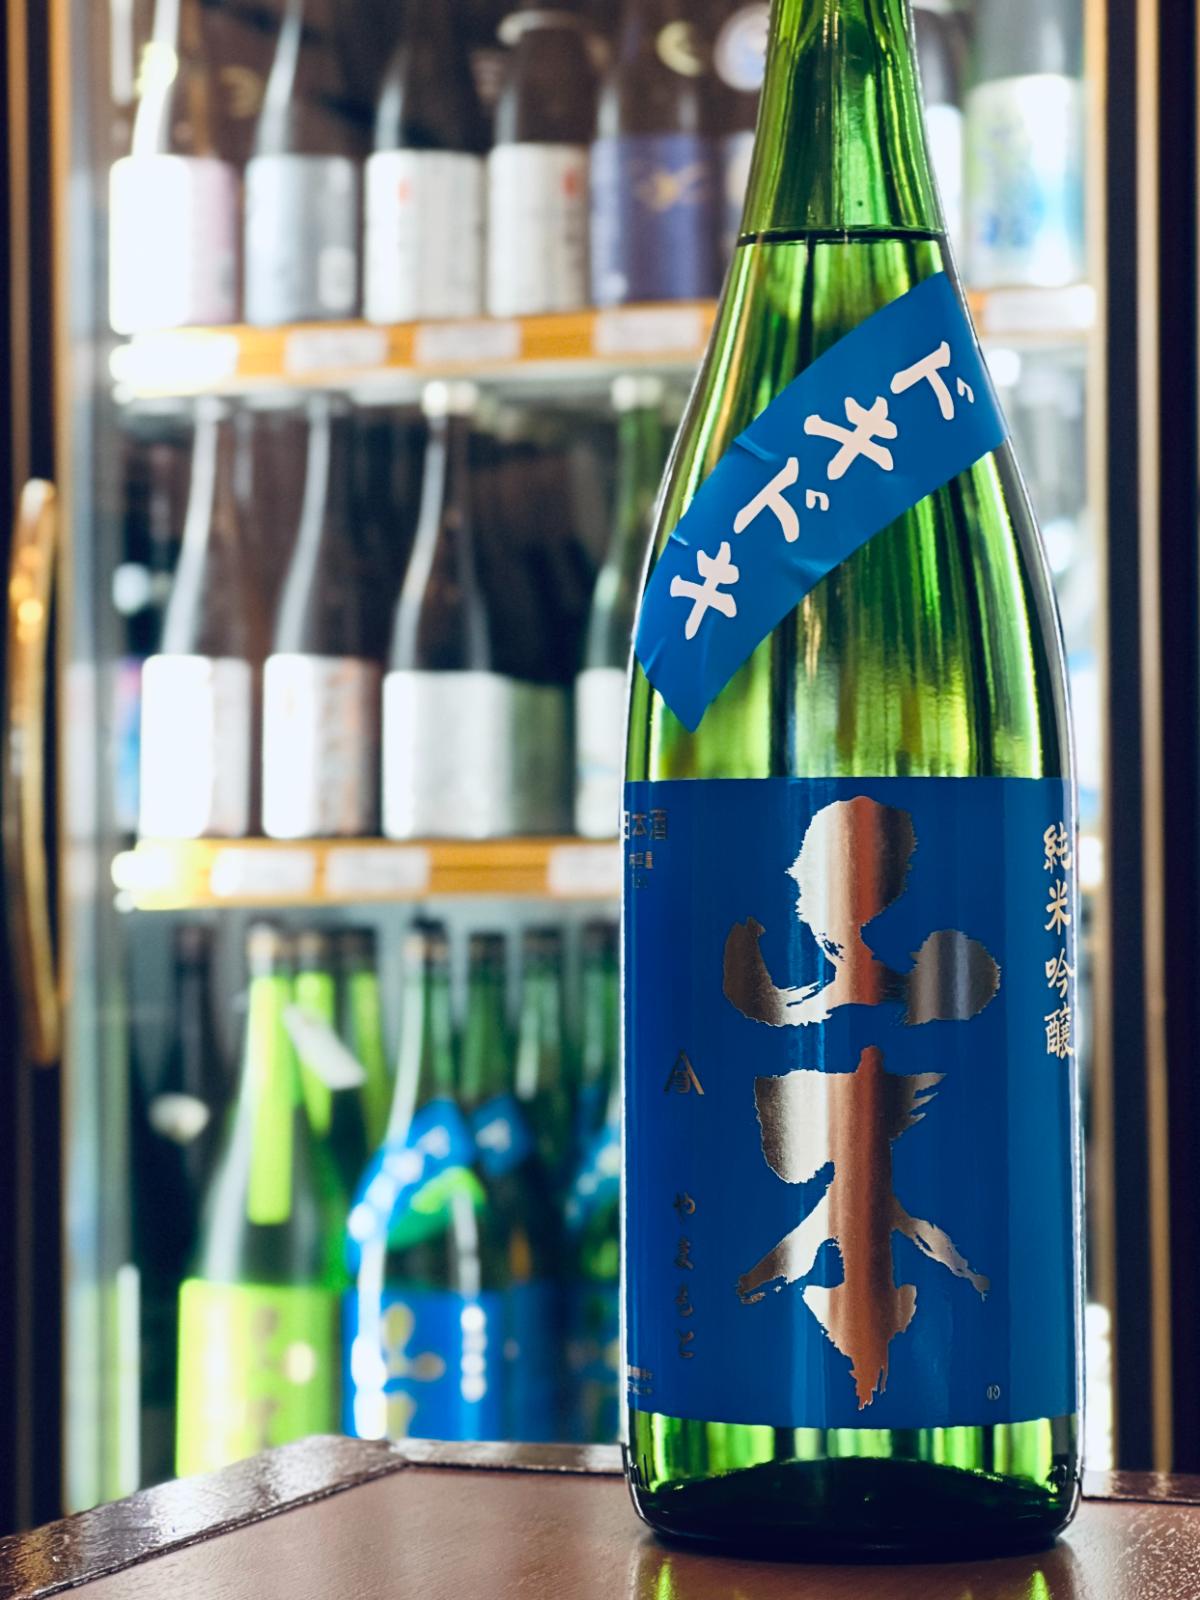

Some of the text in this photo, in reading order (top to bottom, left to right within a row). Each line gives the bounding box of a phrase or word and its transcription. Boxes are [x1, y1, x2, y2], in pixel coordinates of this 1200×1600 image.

[670, 340, 975, 641] ドキドキ
[723, 796, 1001, 1410] 山本
